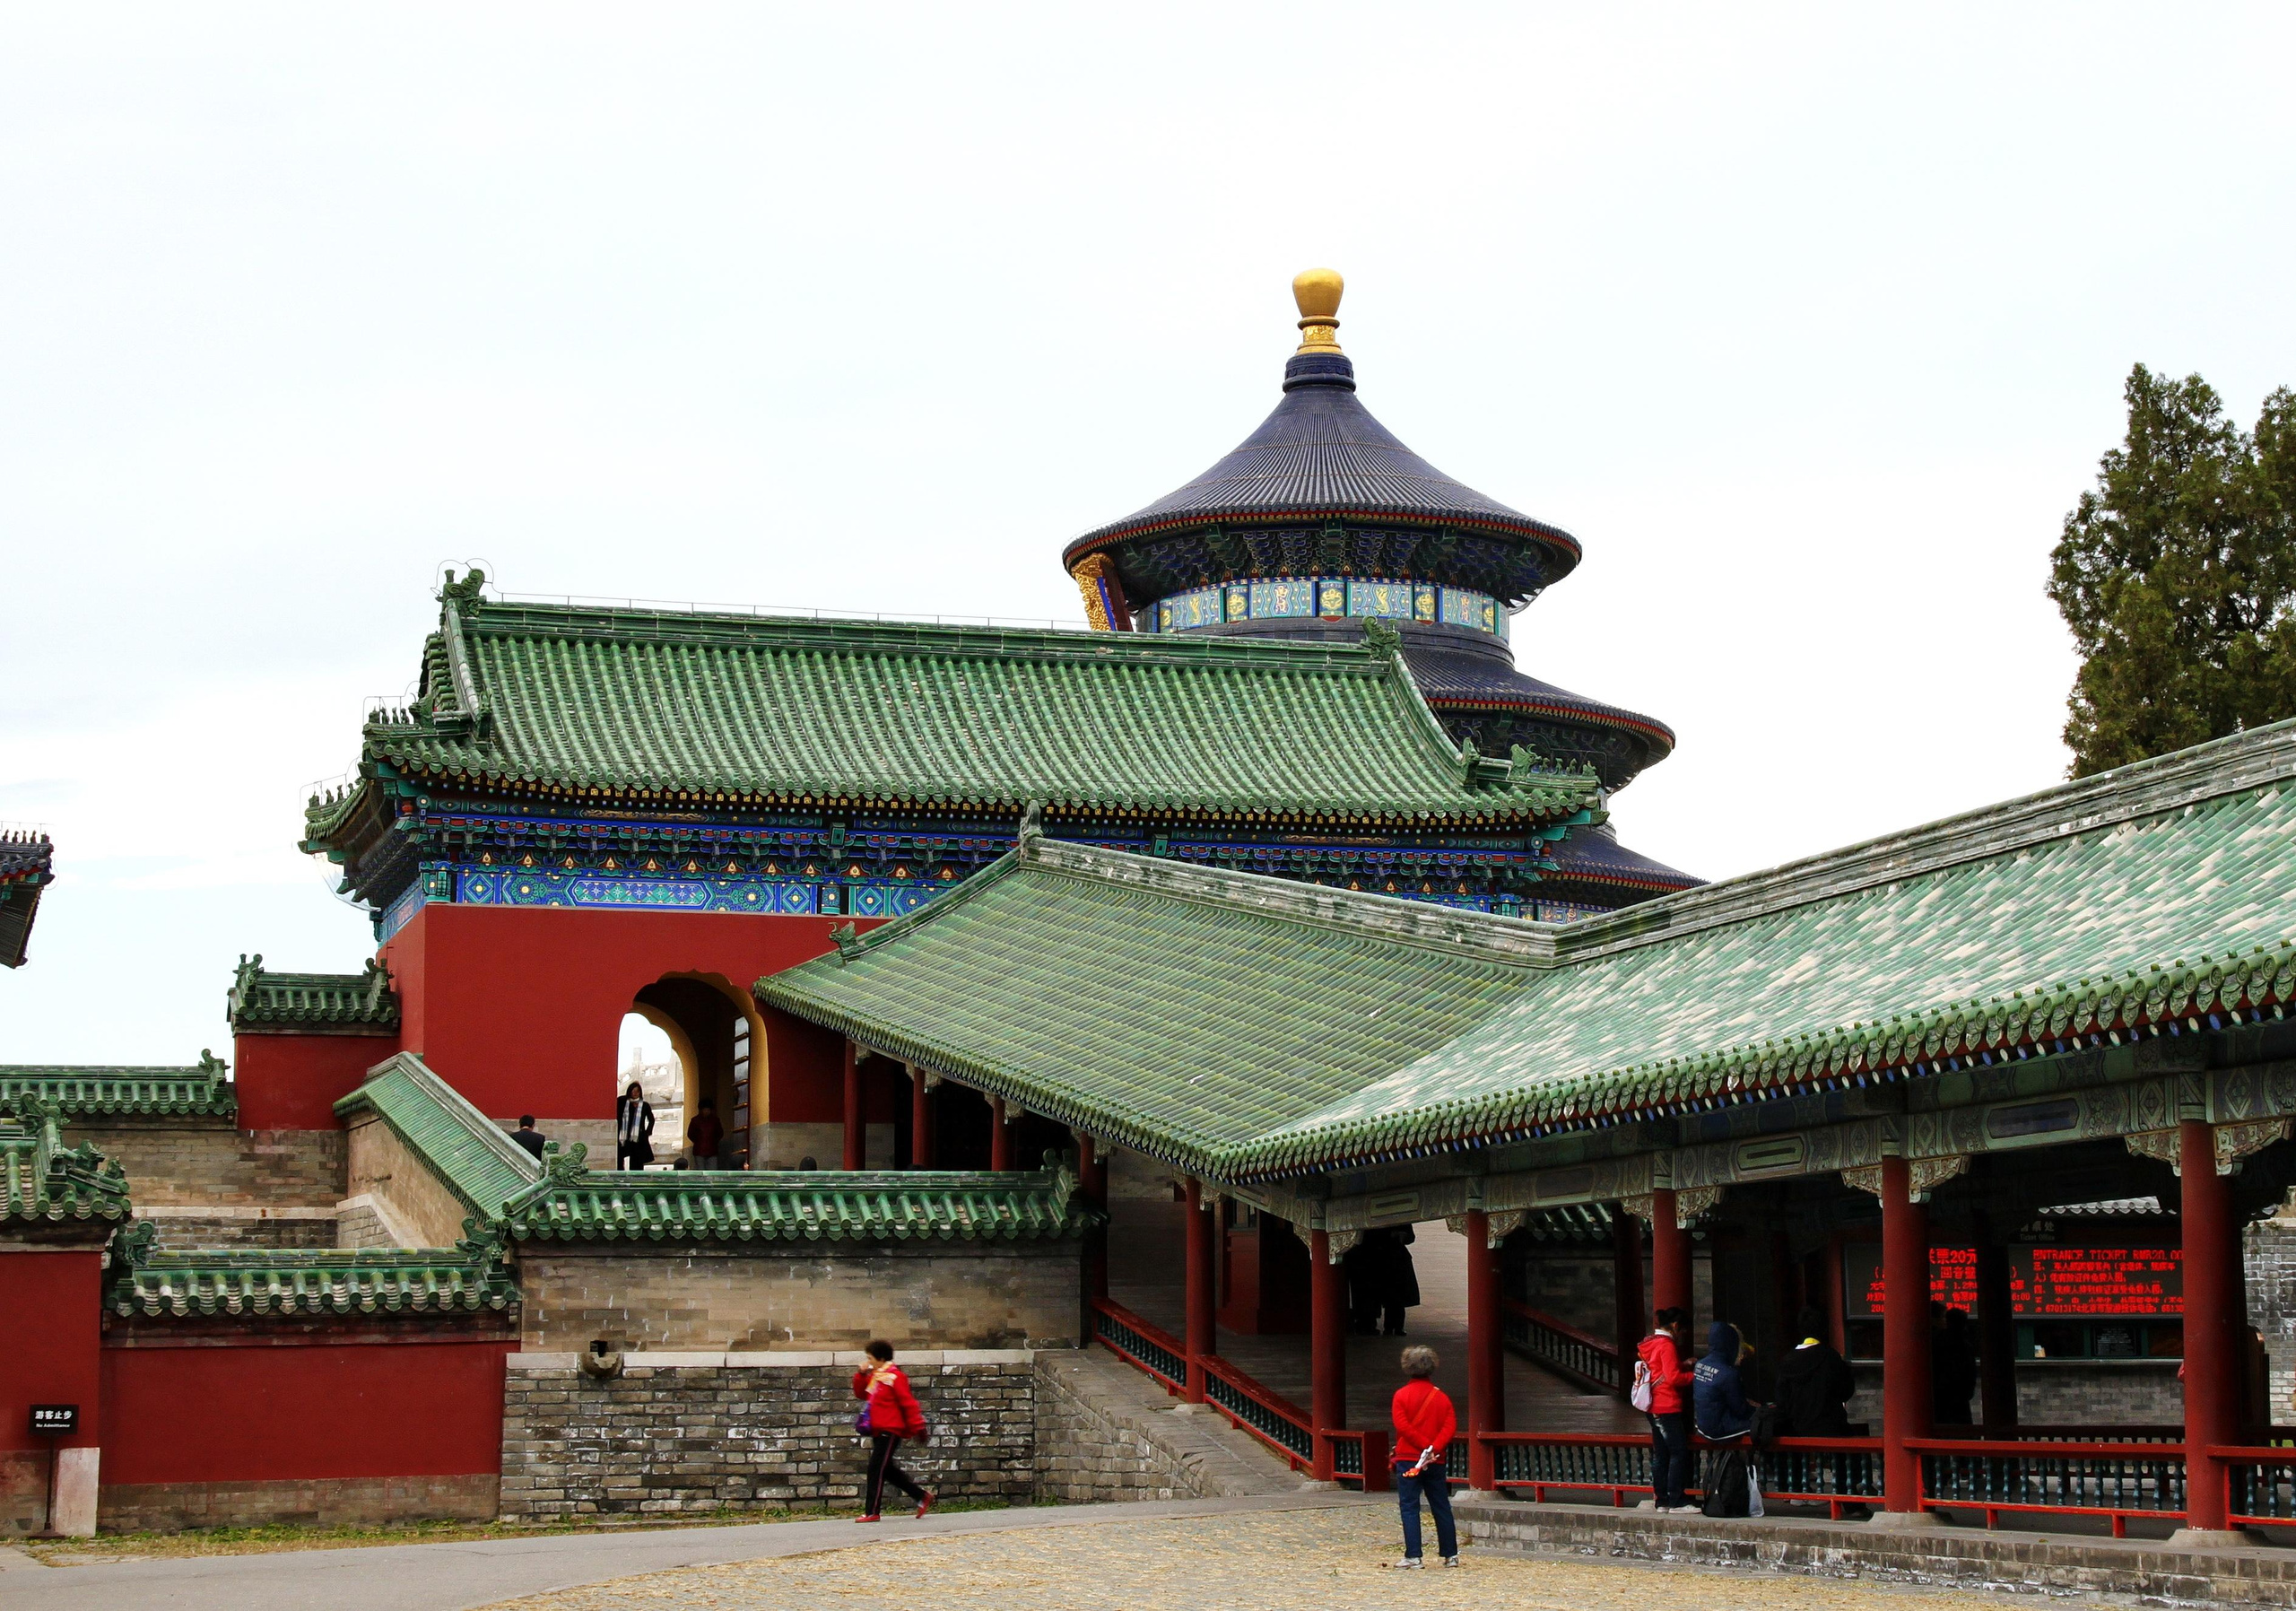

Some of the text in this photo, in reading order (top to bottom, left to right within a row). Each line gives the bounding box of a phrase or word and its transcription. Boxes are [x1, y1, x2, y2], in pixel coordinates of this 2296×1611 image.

[2032, 1250, 2084, 1260] ENTRANCE
[2089, 1250, 2128, 1260] TICKET
[34, 1409, 73, 1420] 游客止步
